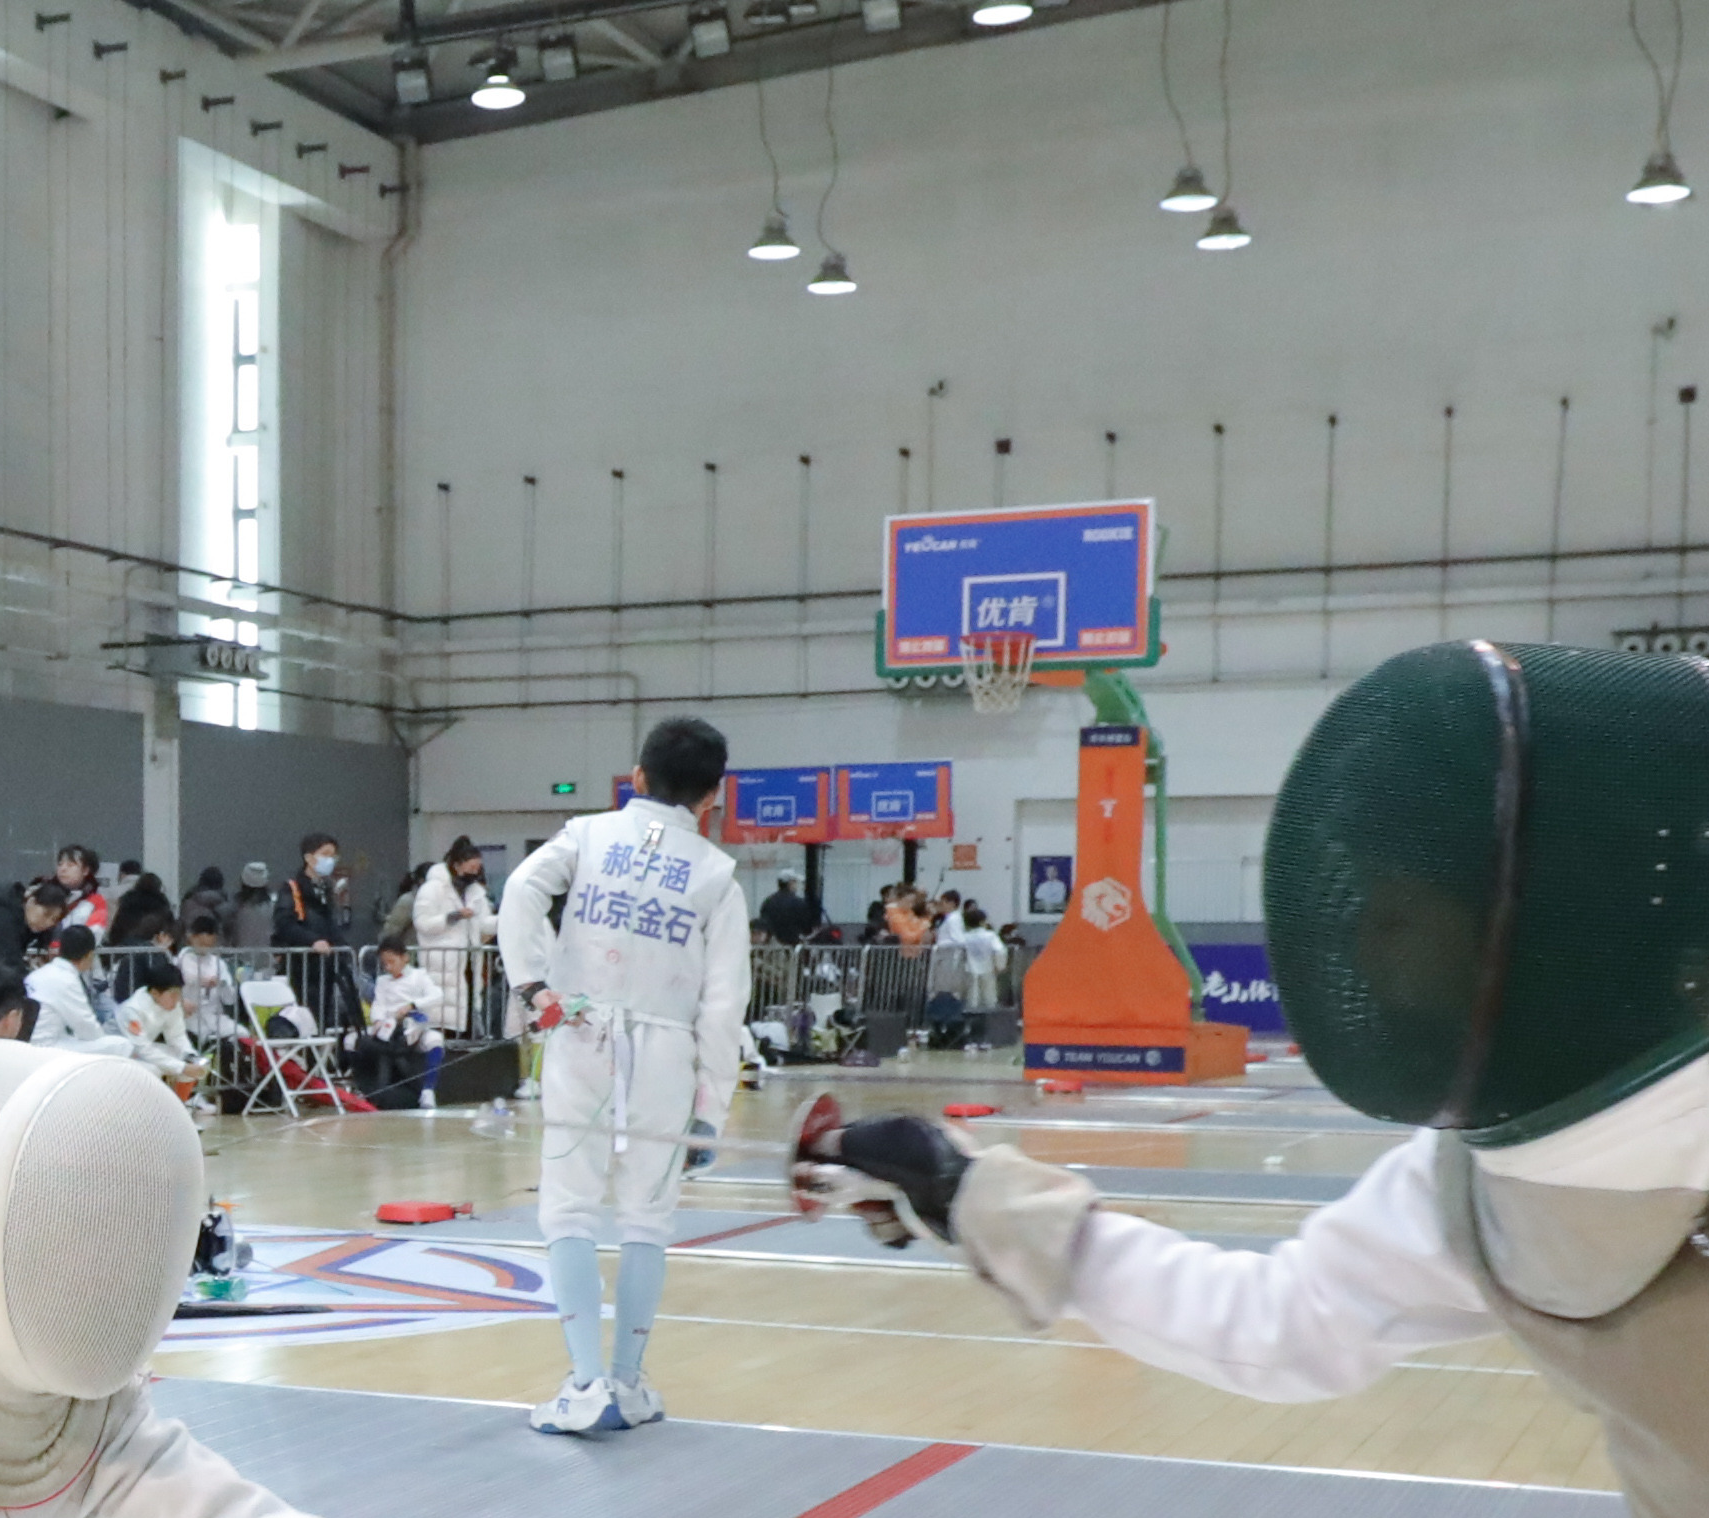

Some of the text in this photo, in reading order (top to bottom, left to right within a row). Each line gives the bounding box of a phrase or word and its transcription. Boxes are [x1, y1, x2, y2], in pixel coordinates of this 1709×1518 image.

[976, 595, 1038, 627] 优肯
[574, 884, 697, 947] 北京金石
